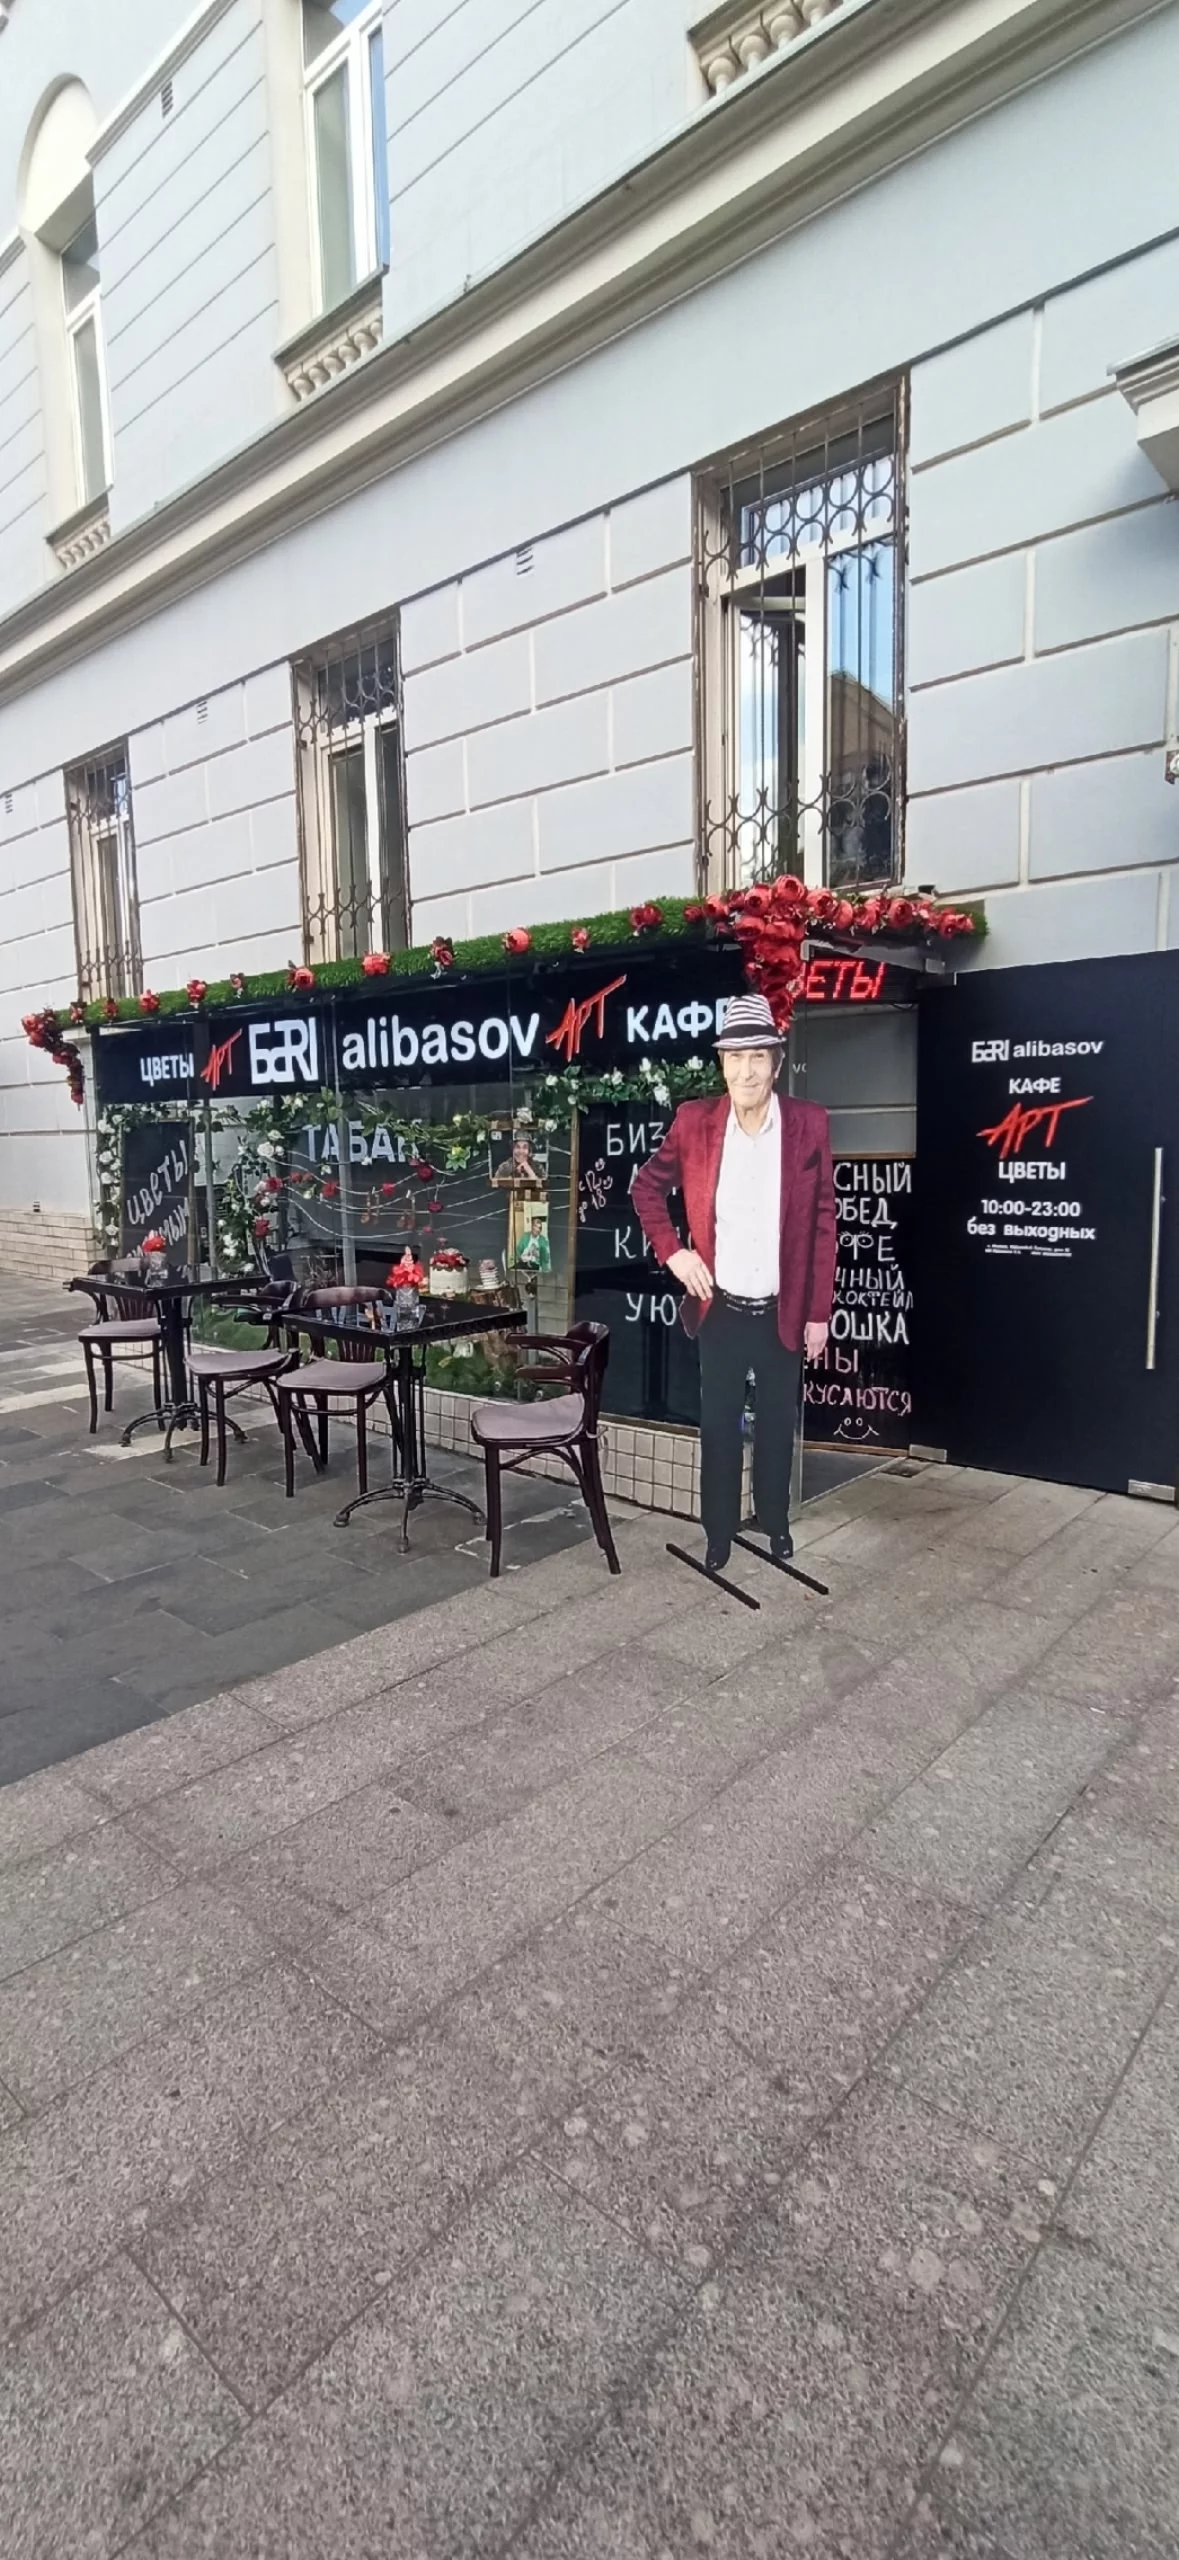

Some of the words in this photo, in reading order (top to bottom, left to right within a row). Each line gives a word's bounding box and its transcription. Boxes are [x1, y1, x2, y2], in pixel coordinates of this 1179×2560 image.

[140, 1052, 195, 1087] ЦВЕТЫ
[200, 1028, 242, 1091] АРТ
[342, 1012, 540, 1069] alibasov
[546, 974, 627, 1062] АРТ
[1012, 1040, 1104, 1058] alibasov
[1008, 1077, 1061, 1094] КАФЕ
[976, 1096, 1095, 1160] АРТ
[998, 1161, 1066, 1184] ЦВЕТЫ
[981, 1199, 1081, 1217] 10:00-23:00
[966, 1216, 996, 1235] без
[1003, 1224, 1096, 1242] выходных
[835, 1232, 896, 1262] ФЕ
[804, 1380, 912, 1417] КУСАЮТСЯ
